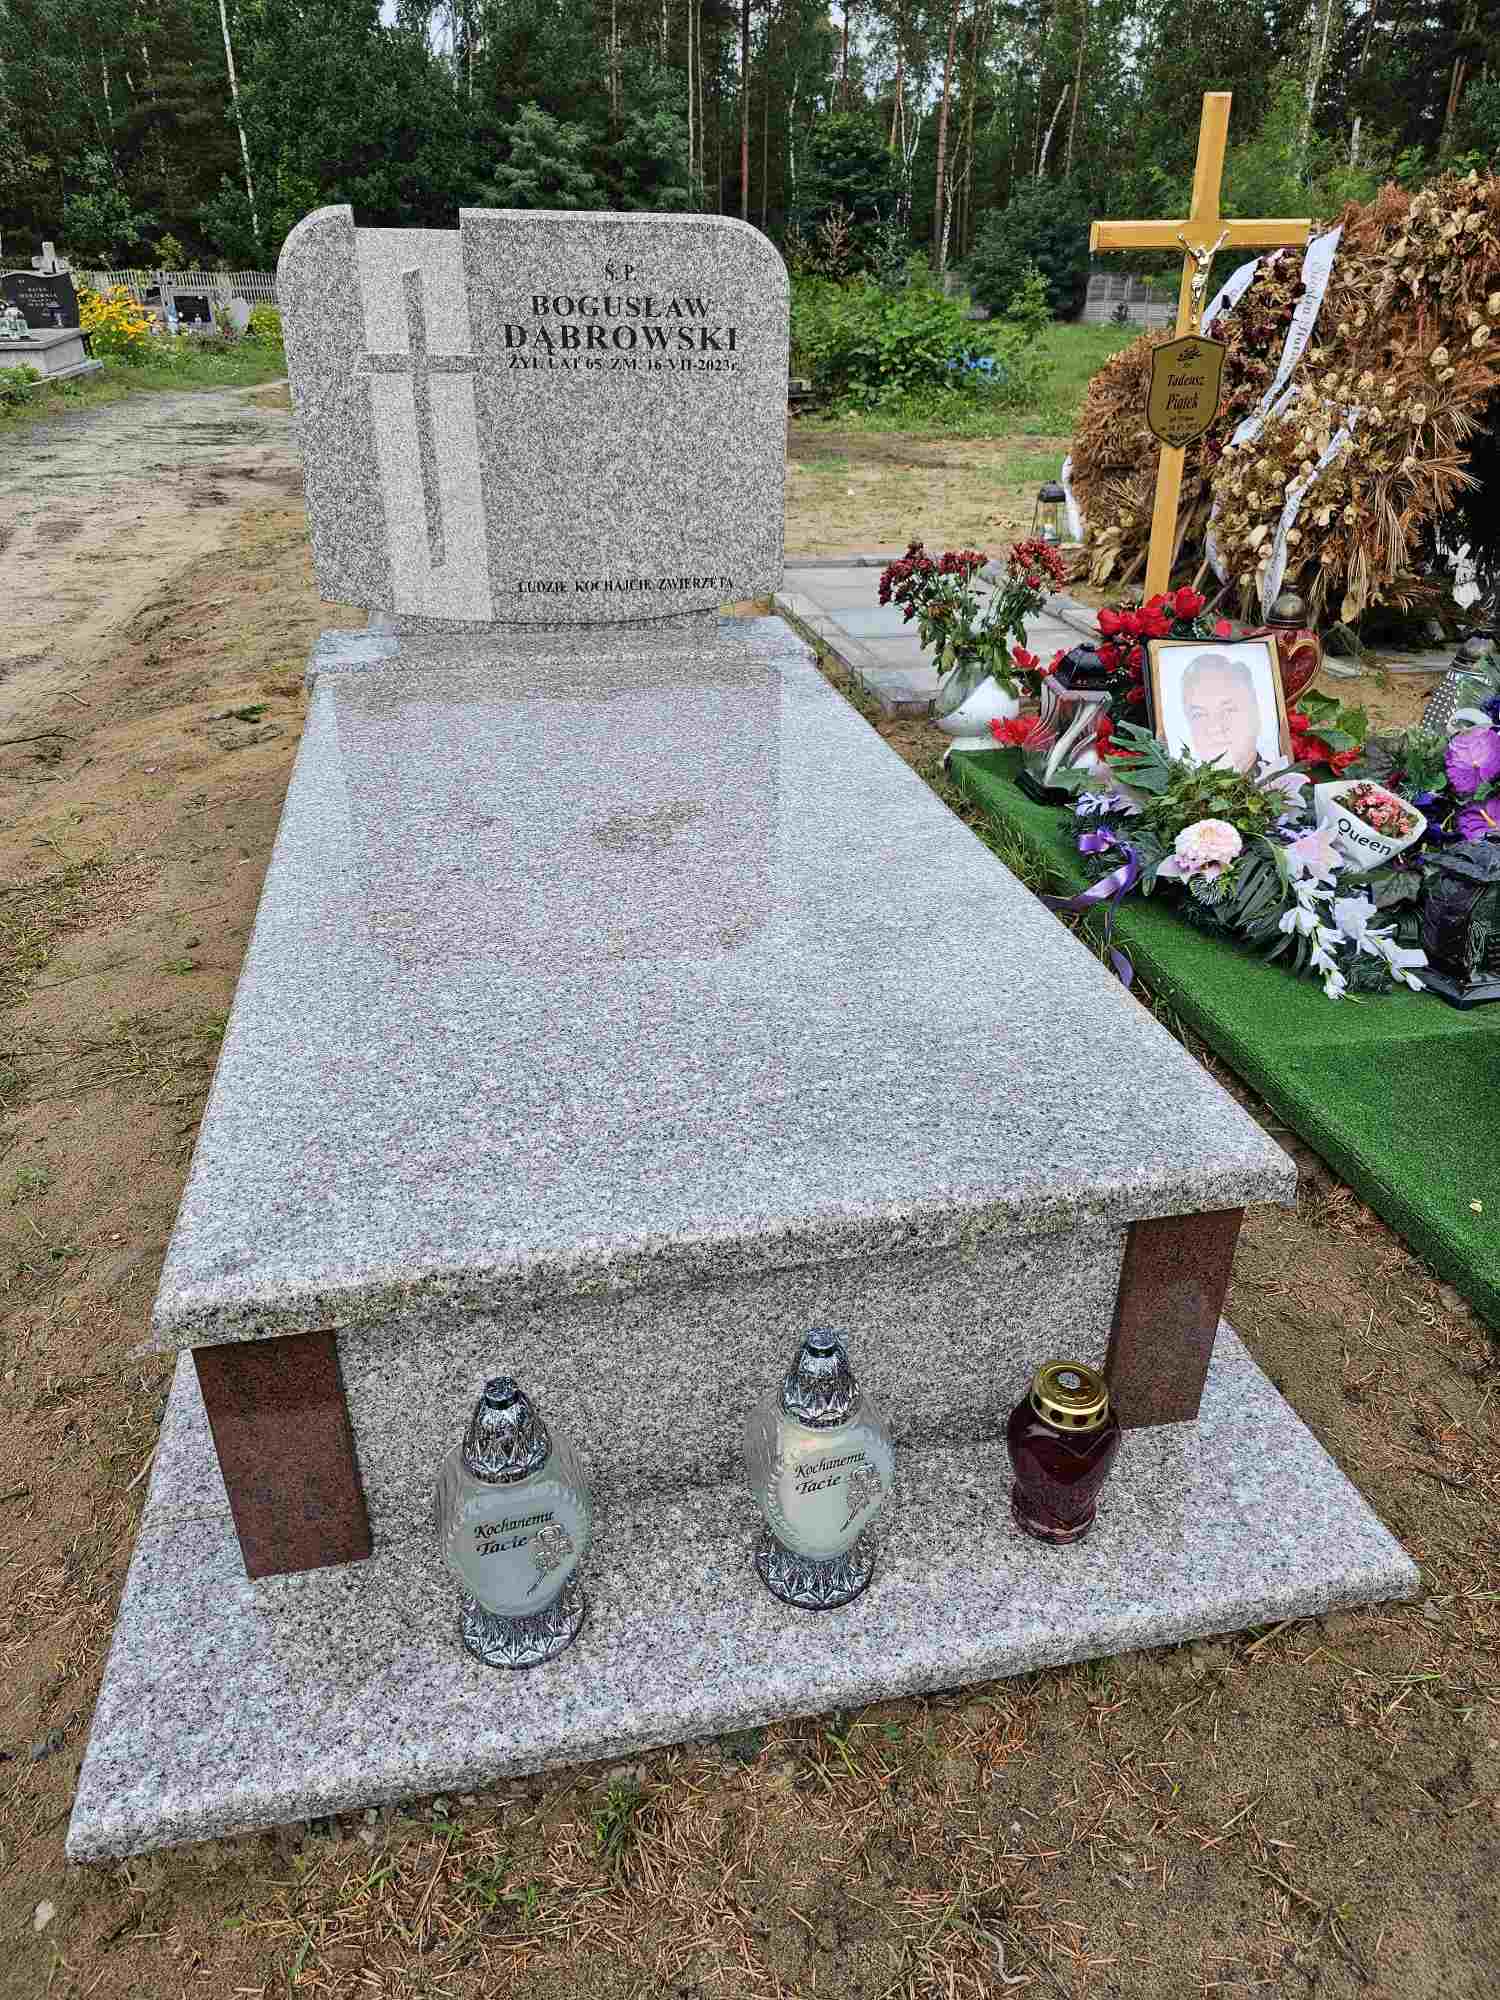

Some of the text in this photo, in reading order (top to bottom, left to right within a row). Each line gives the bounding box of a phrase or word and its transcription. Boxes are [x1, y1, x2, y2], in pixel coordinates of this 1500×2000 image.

[531, 295, 713, 319] BOGUSŁAW
[503, 323, 738, 356] DĄBROWSKI
[547, 356, 581, 370] LAT
[517, 580, 568, 593] LUDZIE
[574, 578, 651, 592] KOCHAJCIE
[1337, 816, 1393, 857] Queen
[794, 1450, 867, 1479] Kochanemu
[795, 1475, 842, 1495] Tacie
[474, 1510, 554, 1539] Kochanemu
[475, 1535, 528, 1557] Tacie
